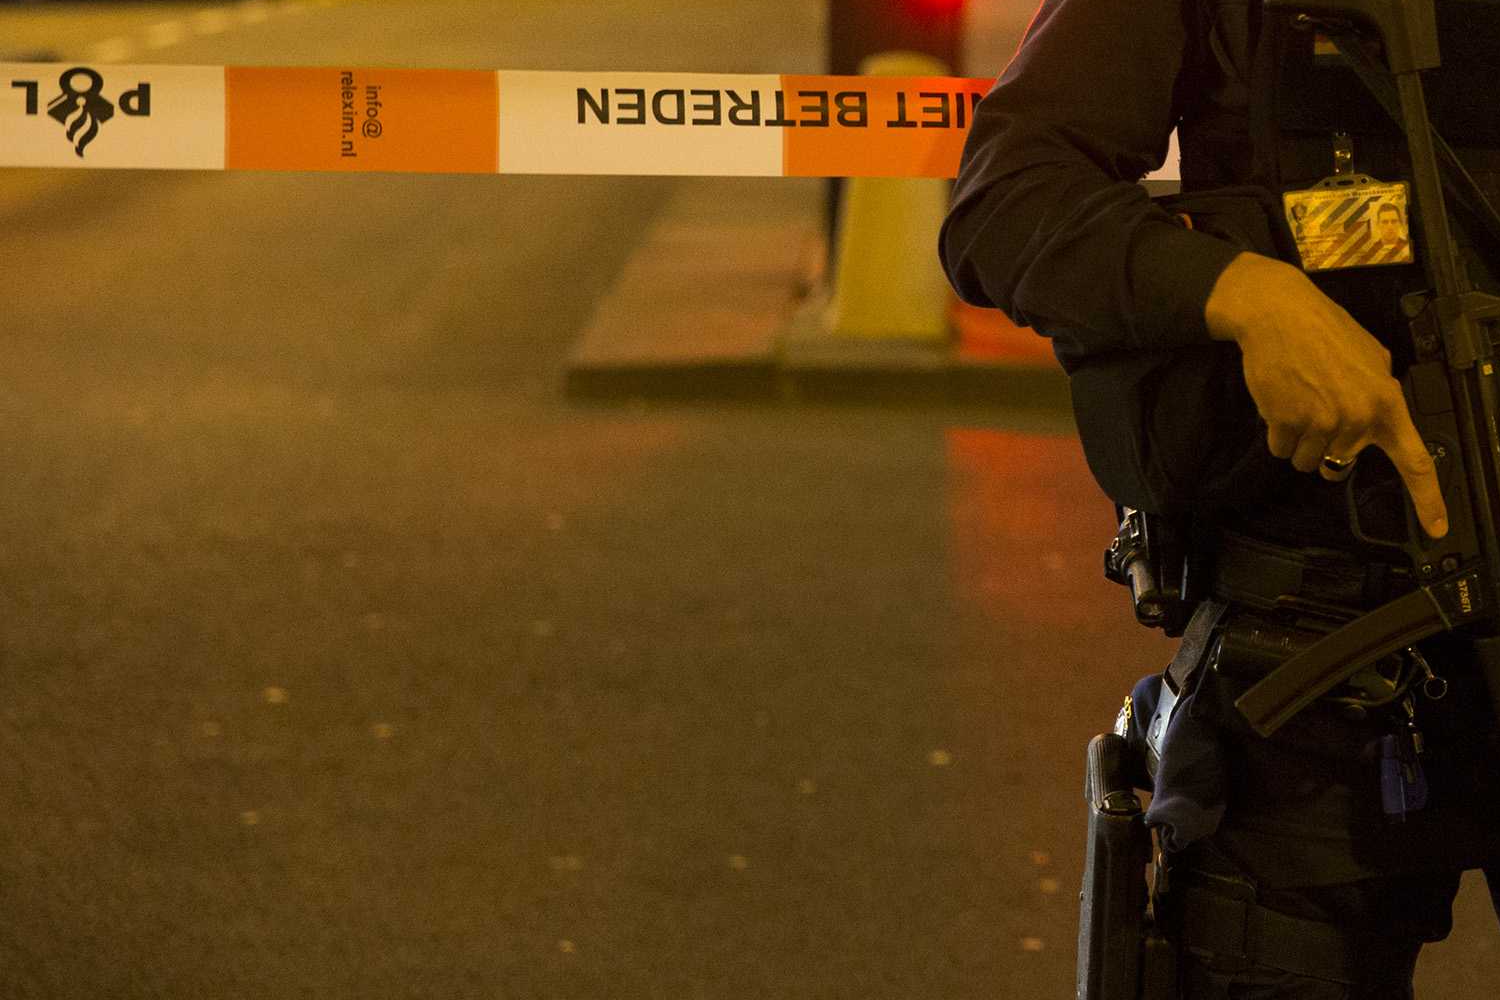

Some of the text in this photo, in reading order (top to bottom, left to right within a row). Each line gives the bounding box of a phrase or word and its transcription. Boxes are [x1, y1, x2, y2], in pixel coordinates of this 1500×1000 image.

[341, 72, 358, 157] relexim.nl
[362, 86, 383, 138] info@
[576, 87, 867, 128] BETREDEN
